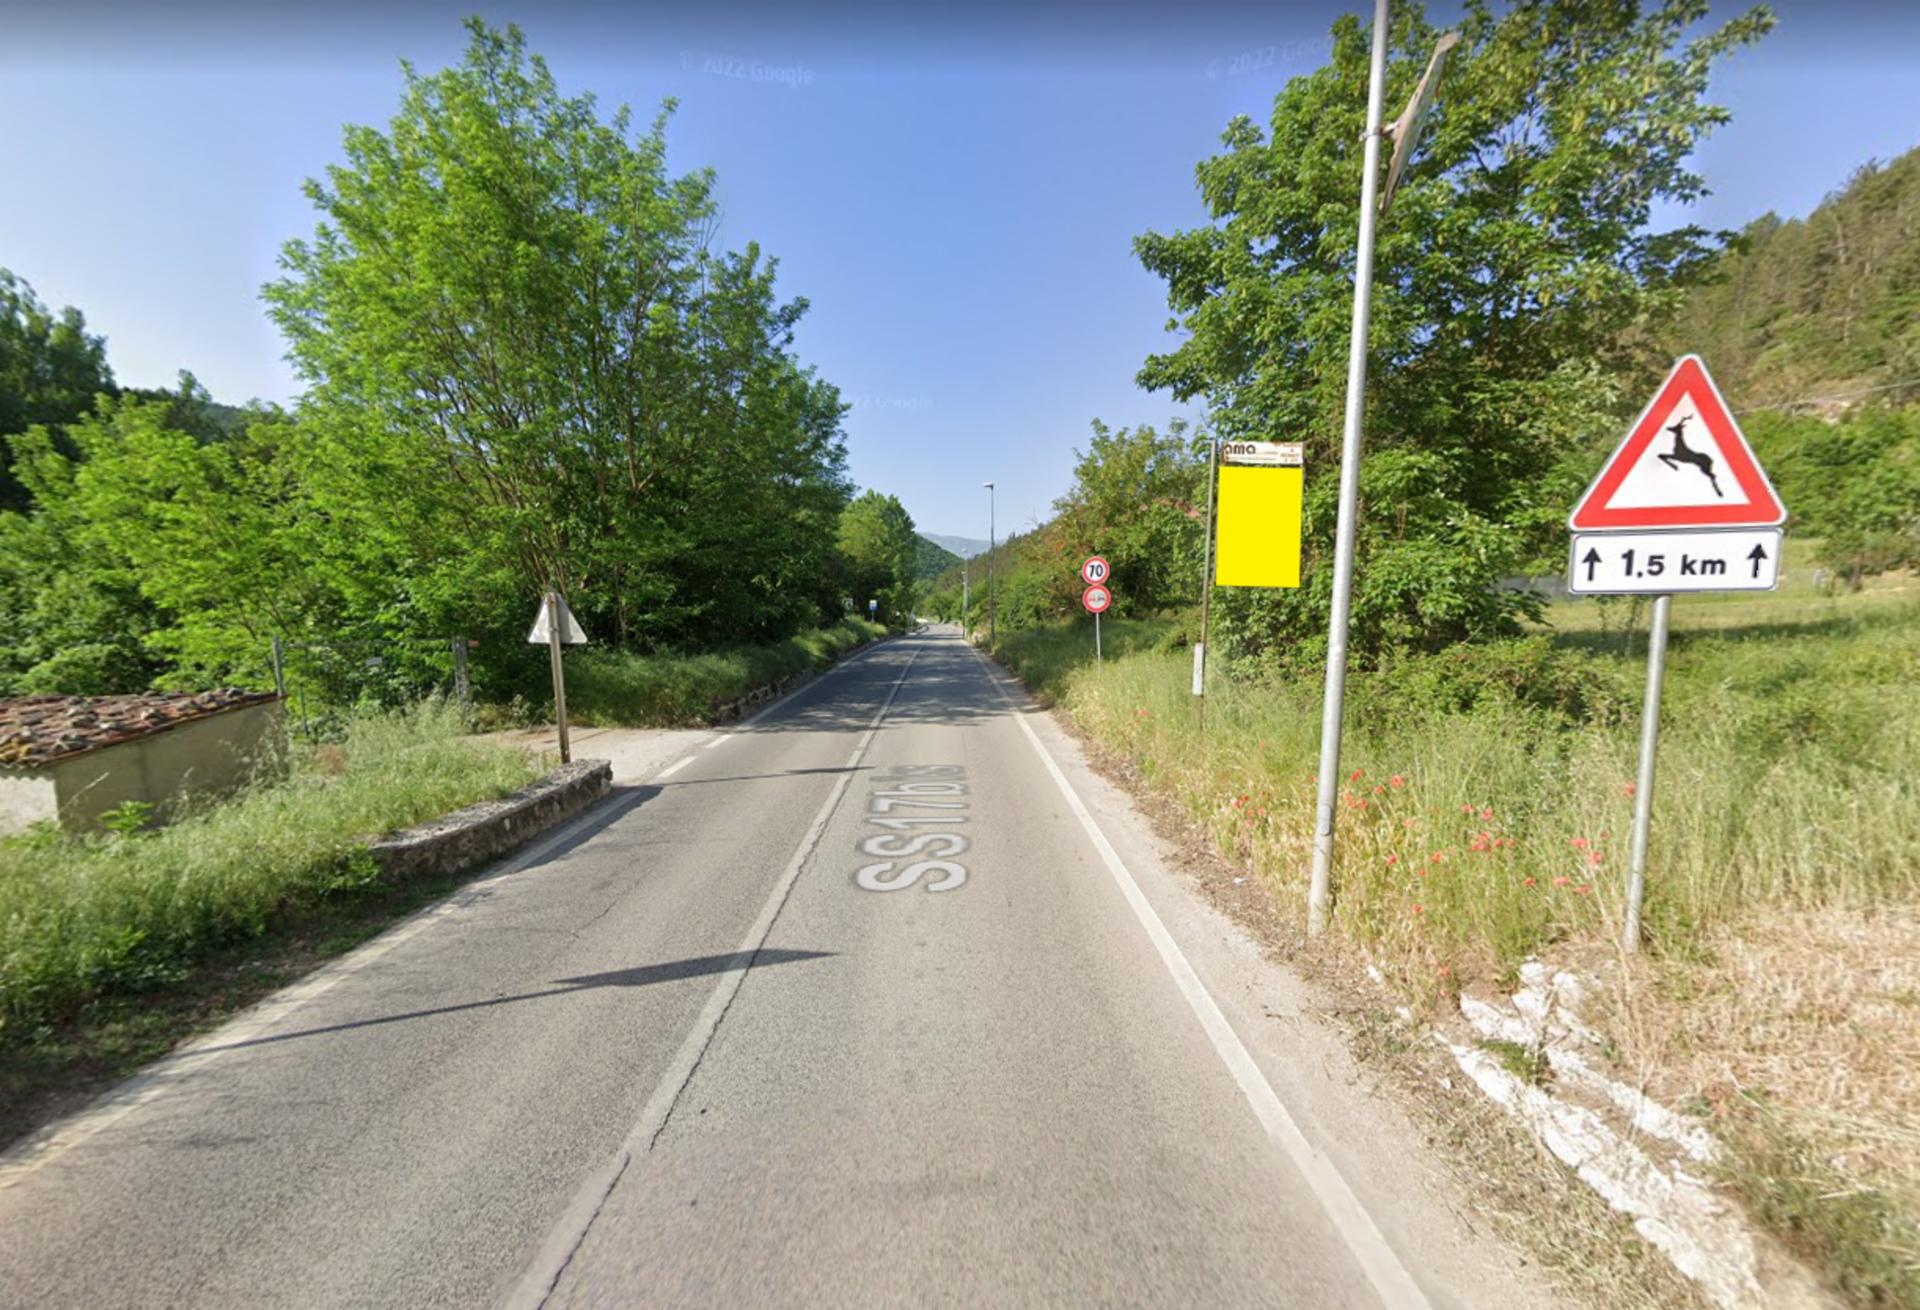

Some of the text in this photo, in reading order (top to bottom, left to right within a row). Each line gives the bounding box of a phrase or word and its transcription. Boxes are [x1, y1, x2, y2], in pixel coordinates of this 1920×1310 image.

[1089, 564, 1104, 578] 70
[1621, 549, 1727, 578] 1.5 km
